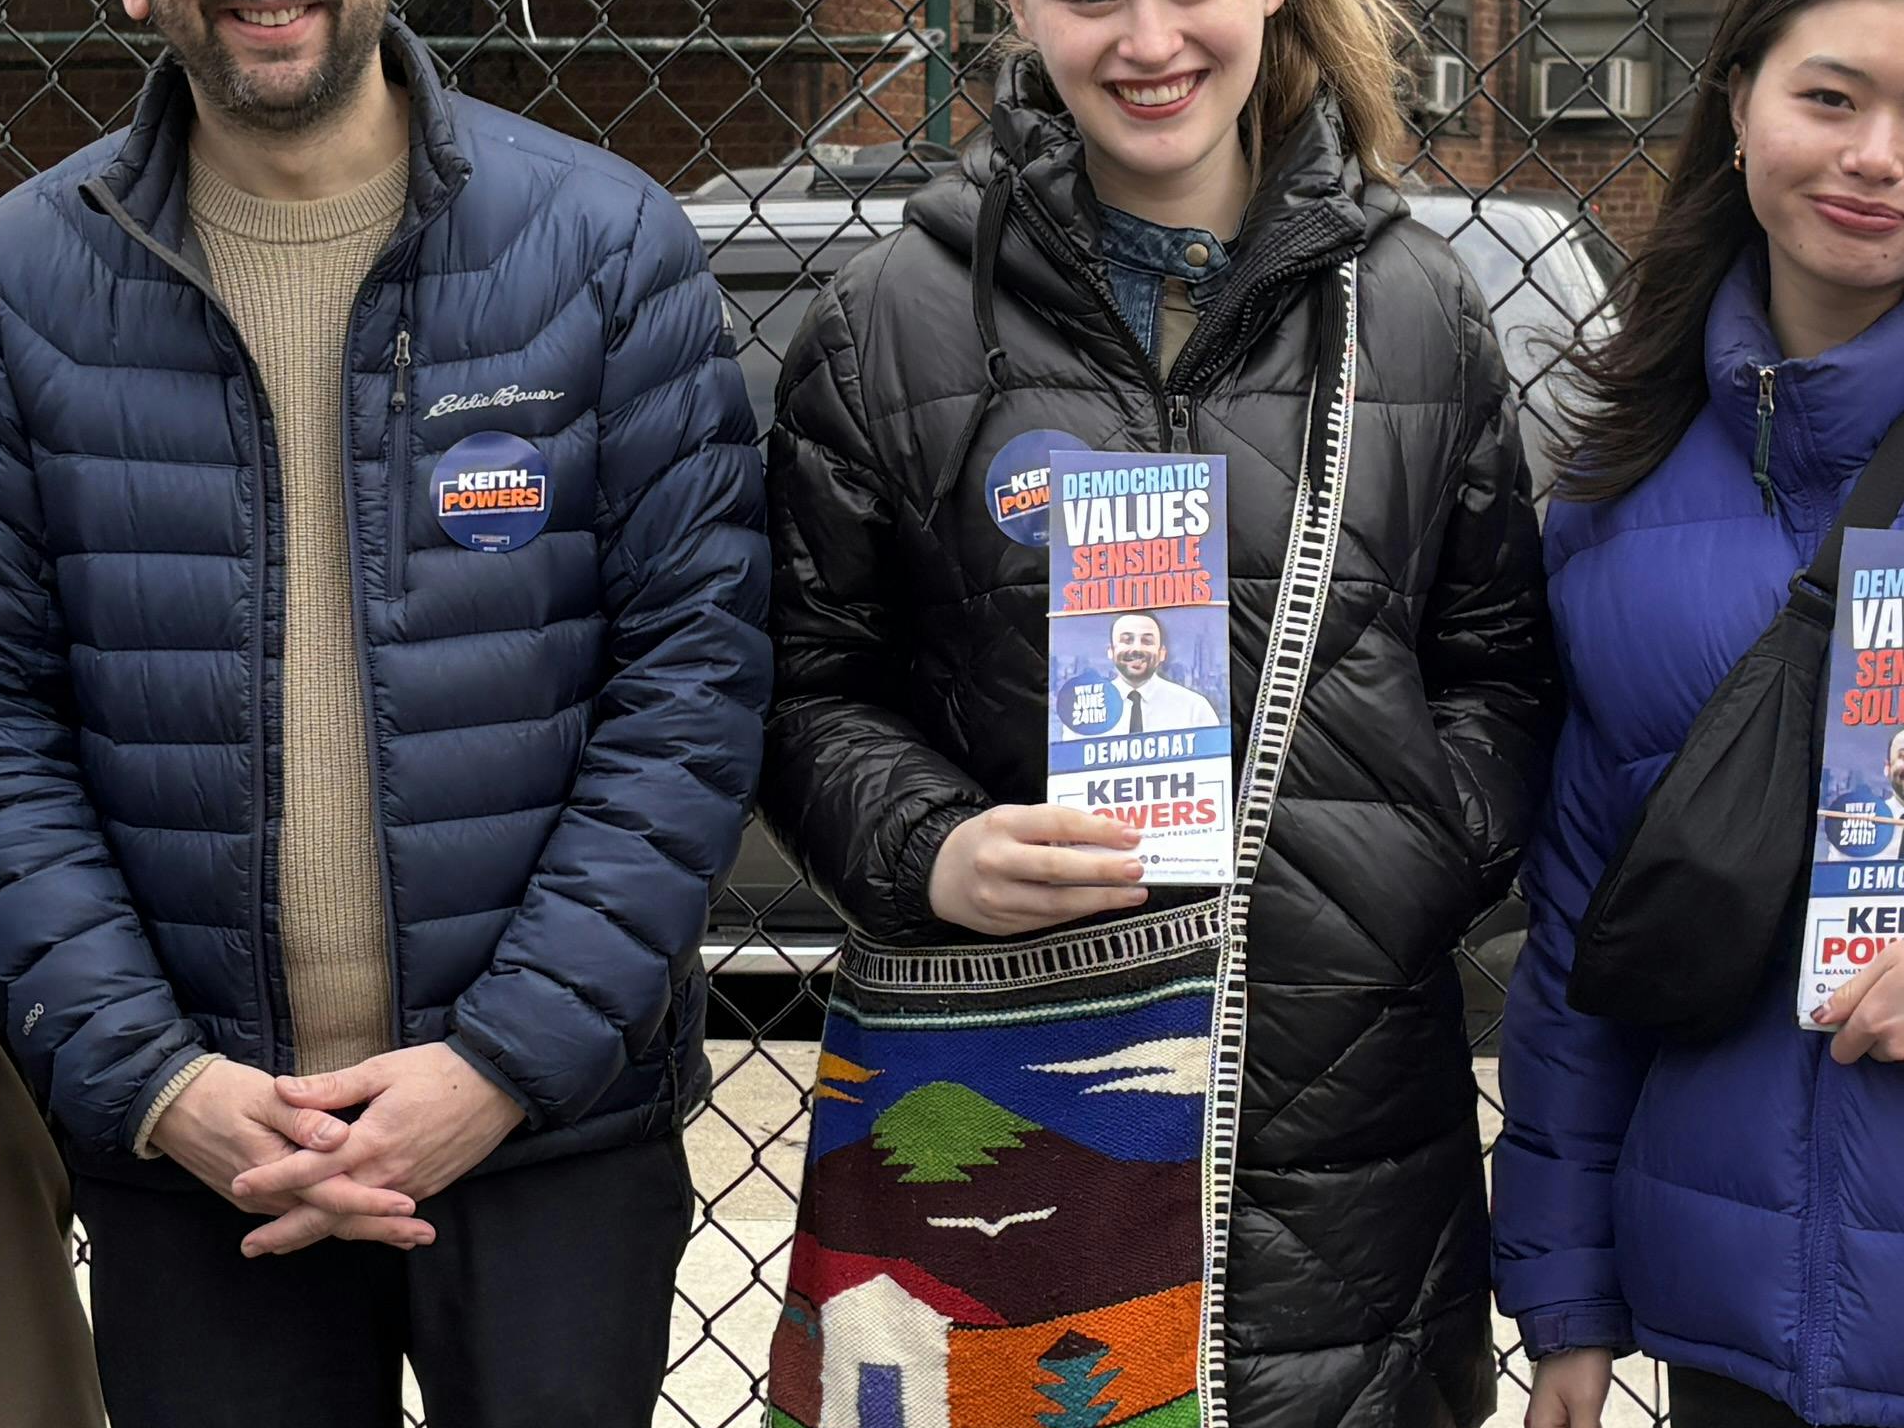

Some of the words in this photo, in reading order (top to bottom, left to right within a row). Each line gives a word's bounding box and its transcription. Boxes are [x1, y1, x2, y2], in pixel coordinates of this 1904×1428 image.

[424, 393, 498, 420] Eddie
[494, 384, 565, 406] Bauer
[458, 469, 527, 491] KEITH
[1010, 468, 1050, 494] KEI
[1063, 462, 1210, 501] DEMOCRATIC
[444, 488, 539, 510] POWERS
[1000, 486, 1050, 514] POW
[1063, 489, 1210, 547] VALUES
[1072, 536, 1203, 581] SENSIBLE
[1063, 571, 1212, 611] SOLUTIONS
[1083, 733, 1196, 765] DEMOCRAT
[1087, 772, 1194, 806] KEITH
[1092, 798, 1217, 830] WERS
